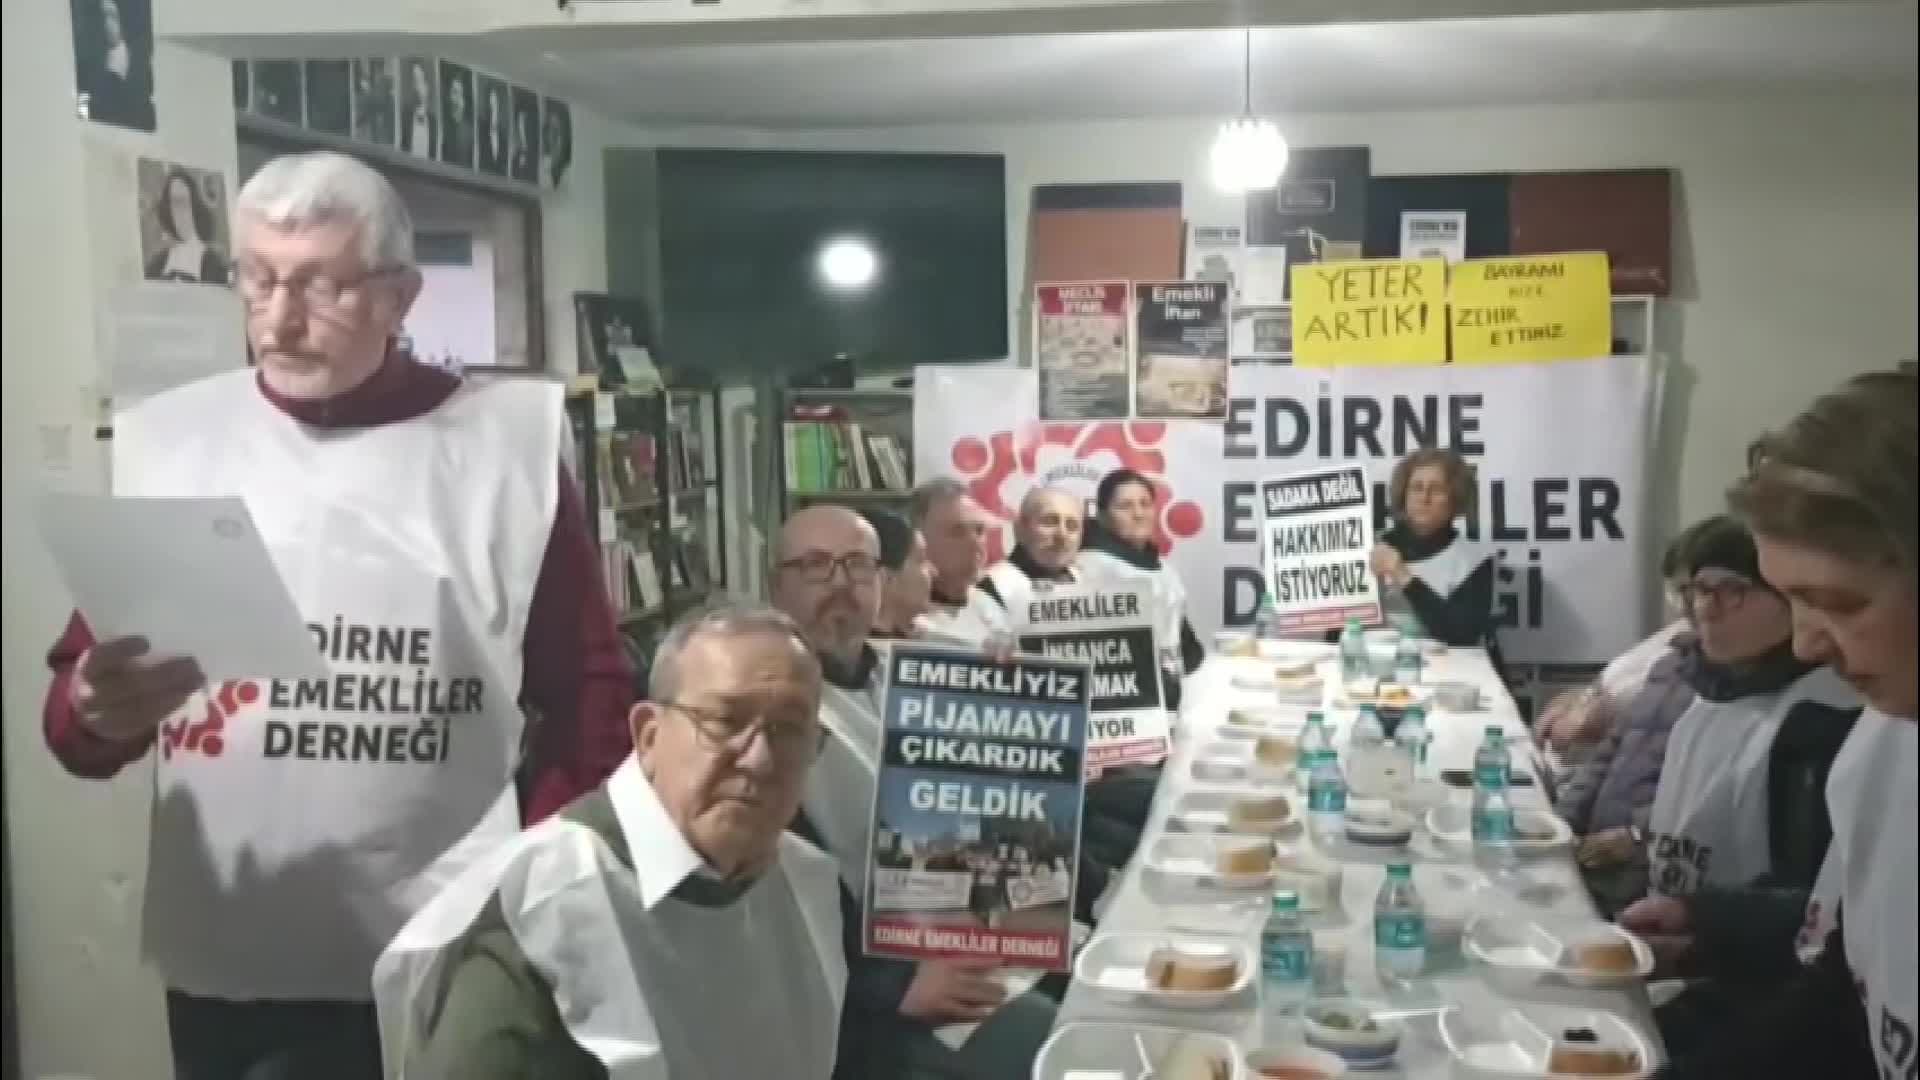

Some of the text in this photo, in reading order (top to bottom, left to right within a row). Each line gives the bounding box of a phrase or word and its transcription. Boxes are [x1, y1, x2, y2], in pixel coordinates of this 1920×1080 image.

[1152, 282, 1215, 302] Emekli
[1317, 263, 1424, 303] YETER
[1304, 303, 1428, 342] ARTIK!
[1223, 381, 1486, 459] EDİRNE
[1267, 470, 1363, 511] SADAKA DEĞİL
[1274, 517, 1363, 559] HAKKIMIZI
[1274, 559, 1370, 603] İSTİYORUZ
[1030, 592, 1139, 624] EMEKLİLER
[269, 667, 483, 714] EMEKLİLER
[899, 660, 1079, 700] EMEKLİYİZ
[899, 692, 1072, 743] PİJAMAYI
[263, 716, 451, 763] DERNEĞİ
[900, 735, 1064, 774] ÇIKARDIK
[910, 780, 1048, 822] GELDİK
[925, 928, 997, 953] EMEKLİLER
